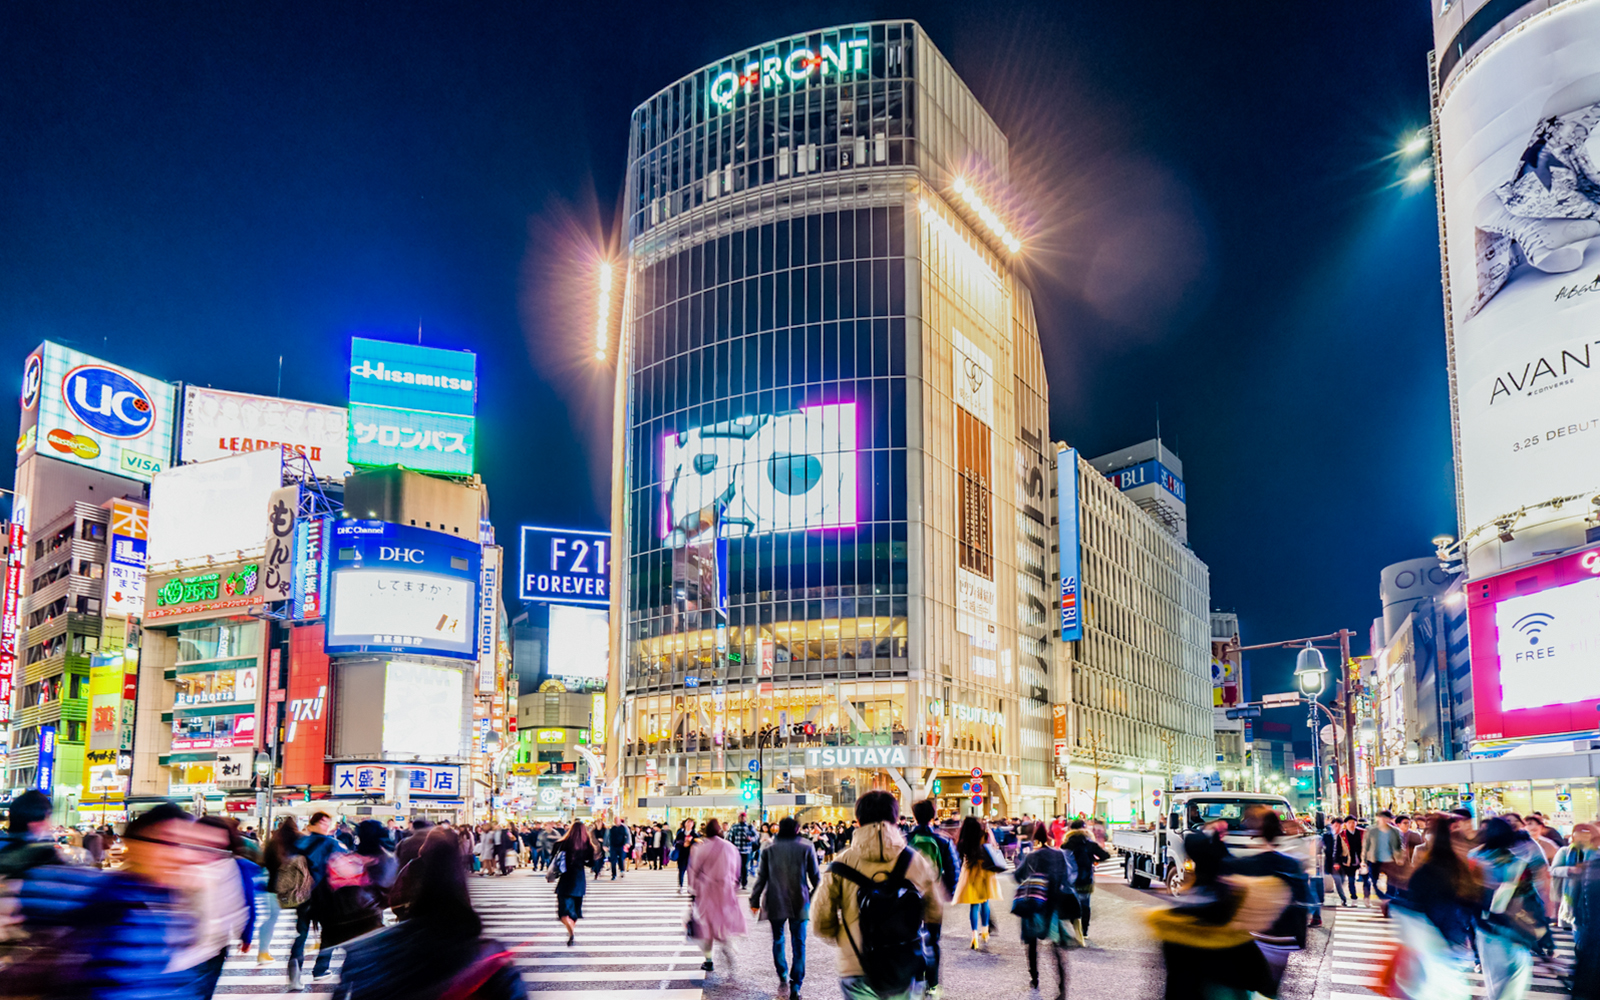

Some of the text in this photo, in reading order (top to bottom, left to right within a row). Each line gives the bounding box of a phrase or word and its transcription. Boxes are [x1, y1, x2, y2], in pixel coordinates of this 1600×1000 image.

[710, 38, 869, 110] QFRONT
[350, 360, 473, 391] Hisamitsu
[1489, 343, 1600, 405] AVAN
[353, 422, 467, 454] サロンパス
[1511, 419, 1600, 452] 3.25 DEBUT
[126, 456, 162, 473] VISA
[302, 521, 321, 612] 三千里薬品
[379, 546, 424, 565] DHC
[550, 537, 605, 575] F21
[526, 573, 606, 596] FOREVER
[482, 564, 496, 655] Taisei neon
[1061, 576, 1076, 629] SEIBU
[1515, 646, 1555, 663] FREE
[177, 689, 235, 706] Euphoria
[808, 747, 906, 767] TSUTAYA
